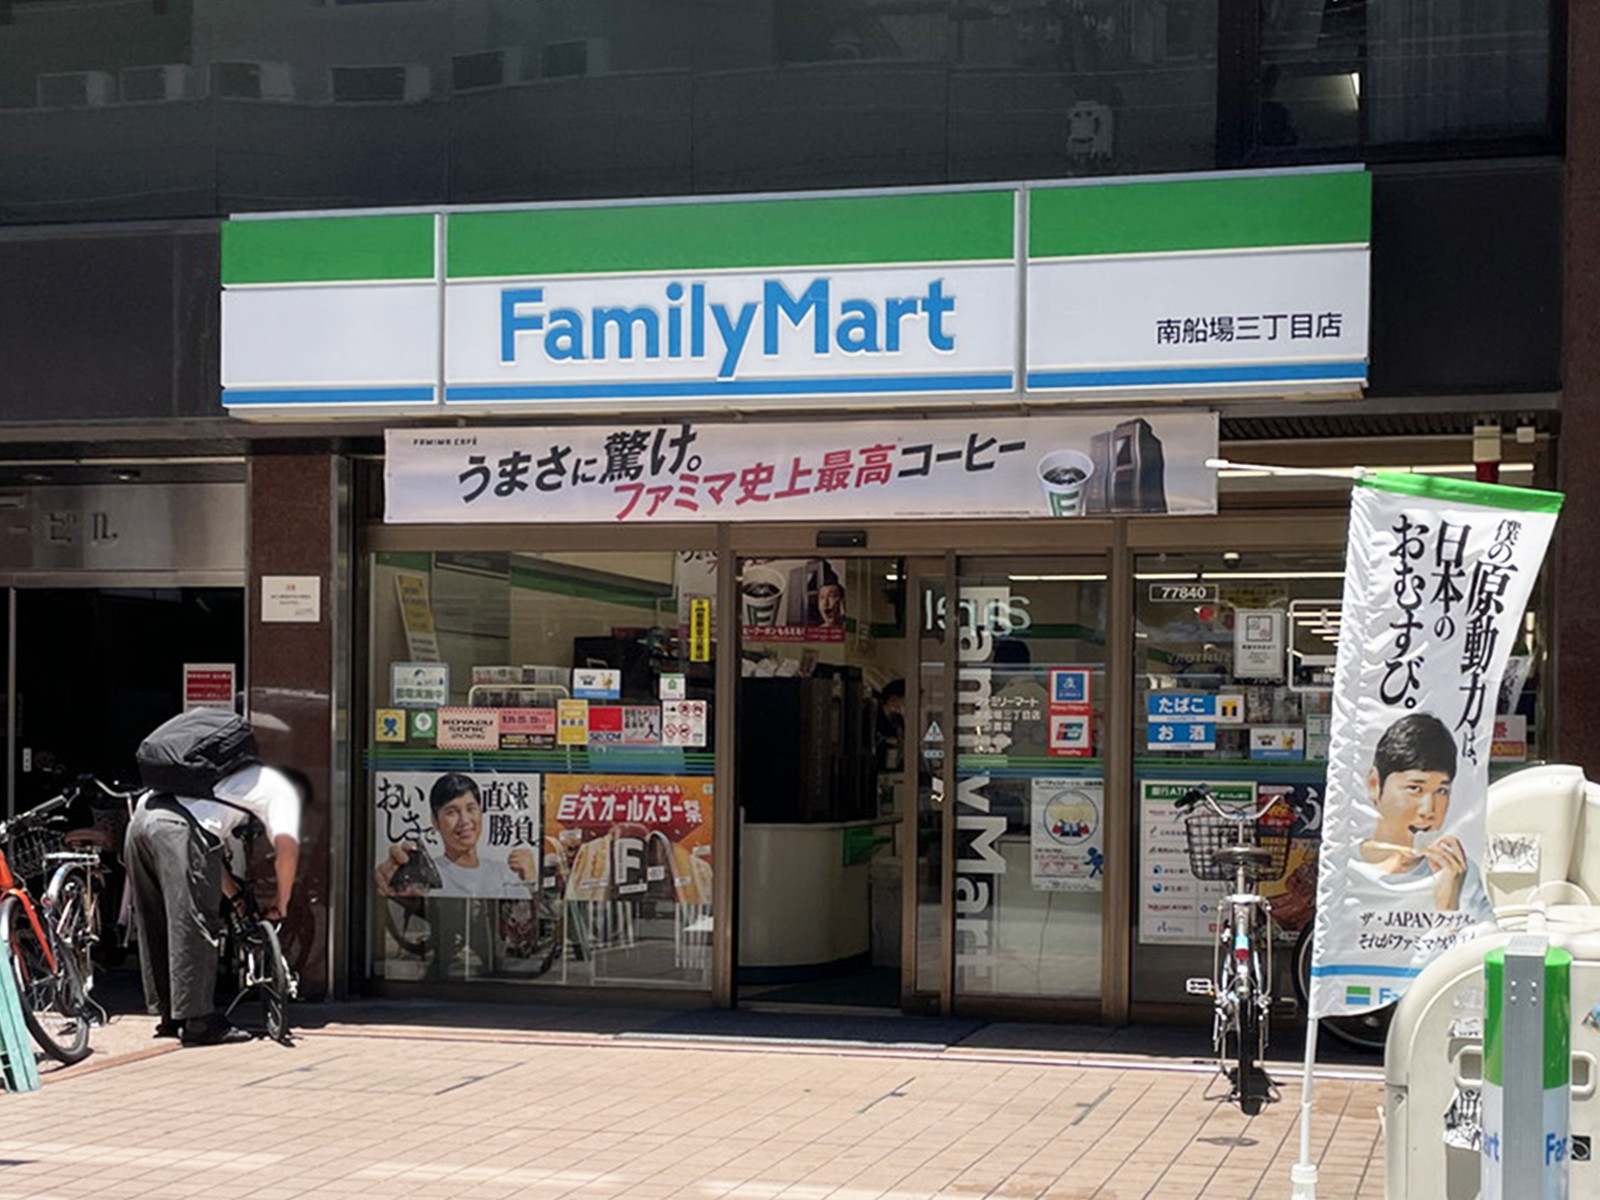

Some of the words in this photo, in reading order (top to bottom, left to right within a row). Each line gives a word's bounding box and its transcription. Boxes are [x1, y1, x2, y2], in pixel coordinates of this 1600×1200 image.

[500, 277, 956, 381] FamilyMart
[1156, 313, 1343, 345] 南船場三丁目店
[458, 425, 703, 503] うまさに驚け。
[614, 433, 1026, 521] ファミマ史上最高コーヒー
[1161, 587, 1207, 599] 77840
[1430, 521, 1471, 642] 日本の
[1379, 514, 1430, 709] おむすび。
[1158, 697, 1206, 714] たばこ
[482, 780, 530, 812] 直球
[556, 793, 703, 824] 巨大オールスター祭
